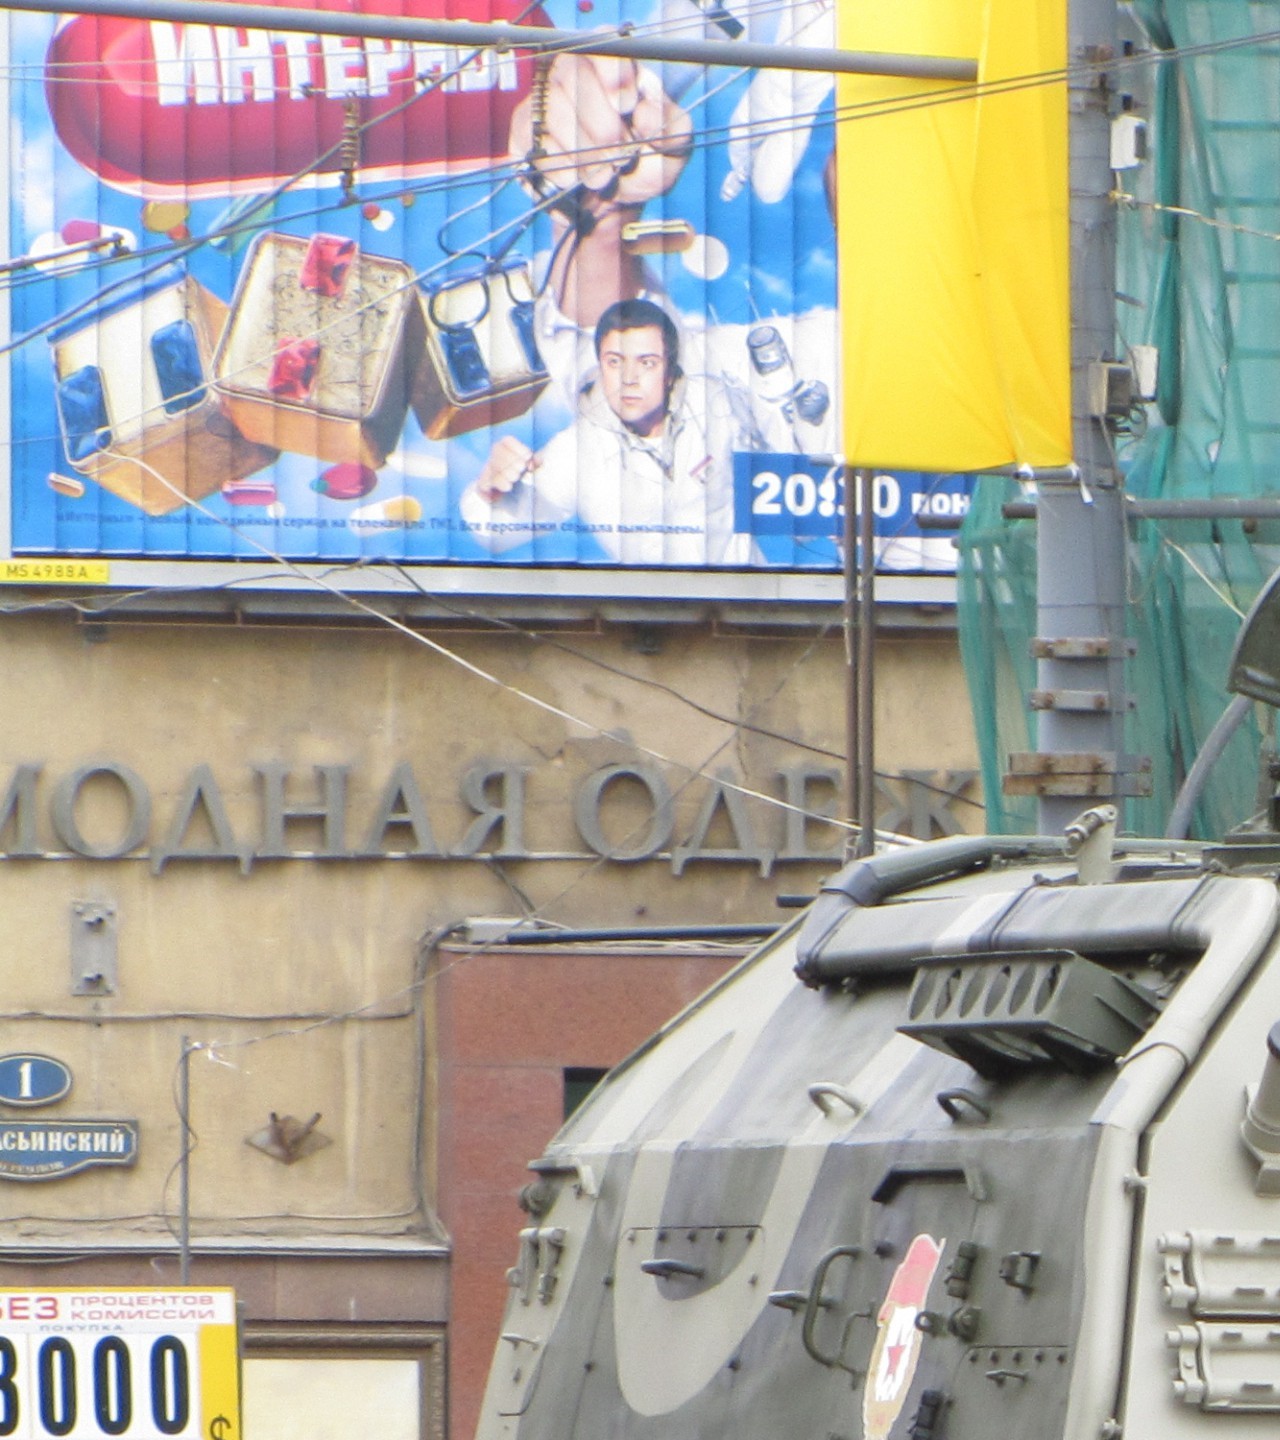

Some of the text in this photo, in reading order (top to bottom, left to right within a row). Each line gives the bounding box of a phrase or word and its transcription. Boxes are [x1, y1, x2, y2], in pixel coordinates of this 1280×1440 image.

[19, 1062, 33, 1097] 1
[0, 1129, 125, 1152] СЬИНСКИЙ
[0, 1295, 214, 1320] ЕЗ ПРОЦЕНТОВ
[70, 1309, 215, 1320] КОМИССИИ
[39, 1324, 124, 1332] ПОКУПКА
